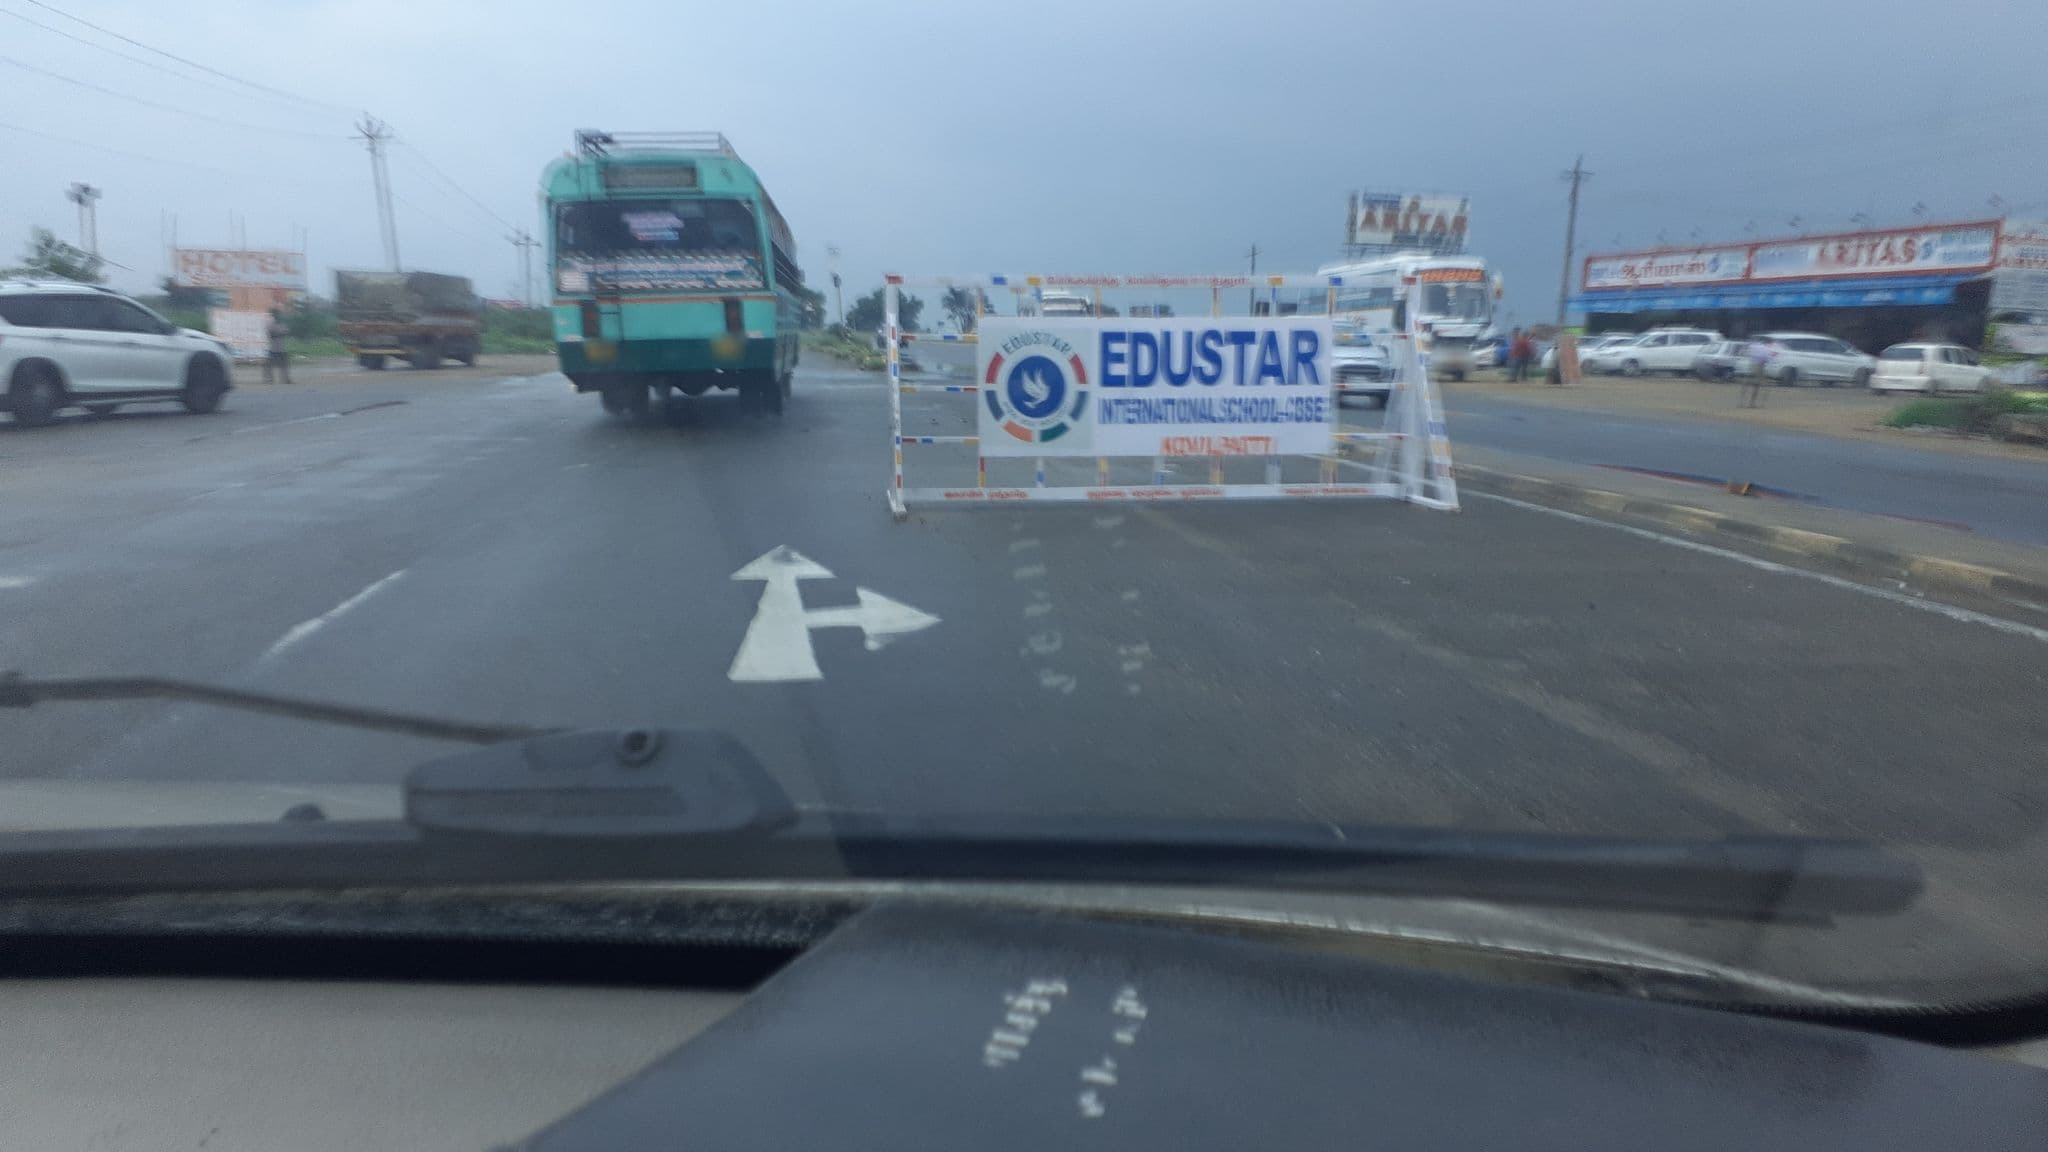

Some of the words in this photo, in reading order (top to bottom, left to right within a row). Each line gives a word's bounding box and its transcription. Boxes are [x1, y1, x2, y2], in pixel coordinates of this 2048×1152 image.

[180, 250, 300, 275] HOTEL
[1100, 329, 1323, 388] EDUSTAR
[1098, 397, 1219, 424] INTERNATIONAL
